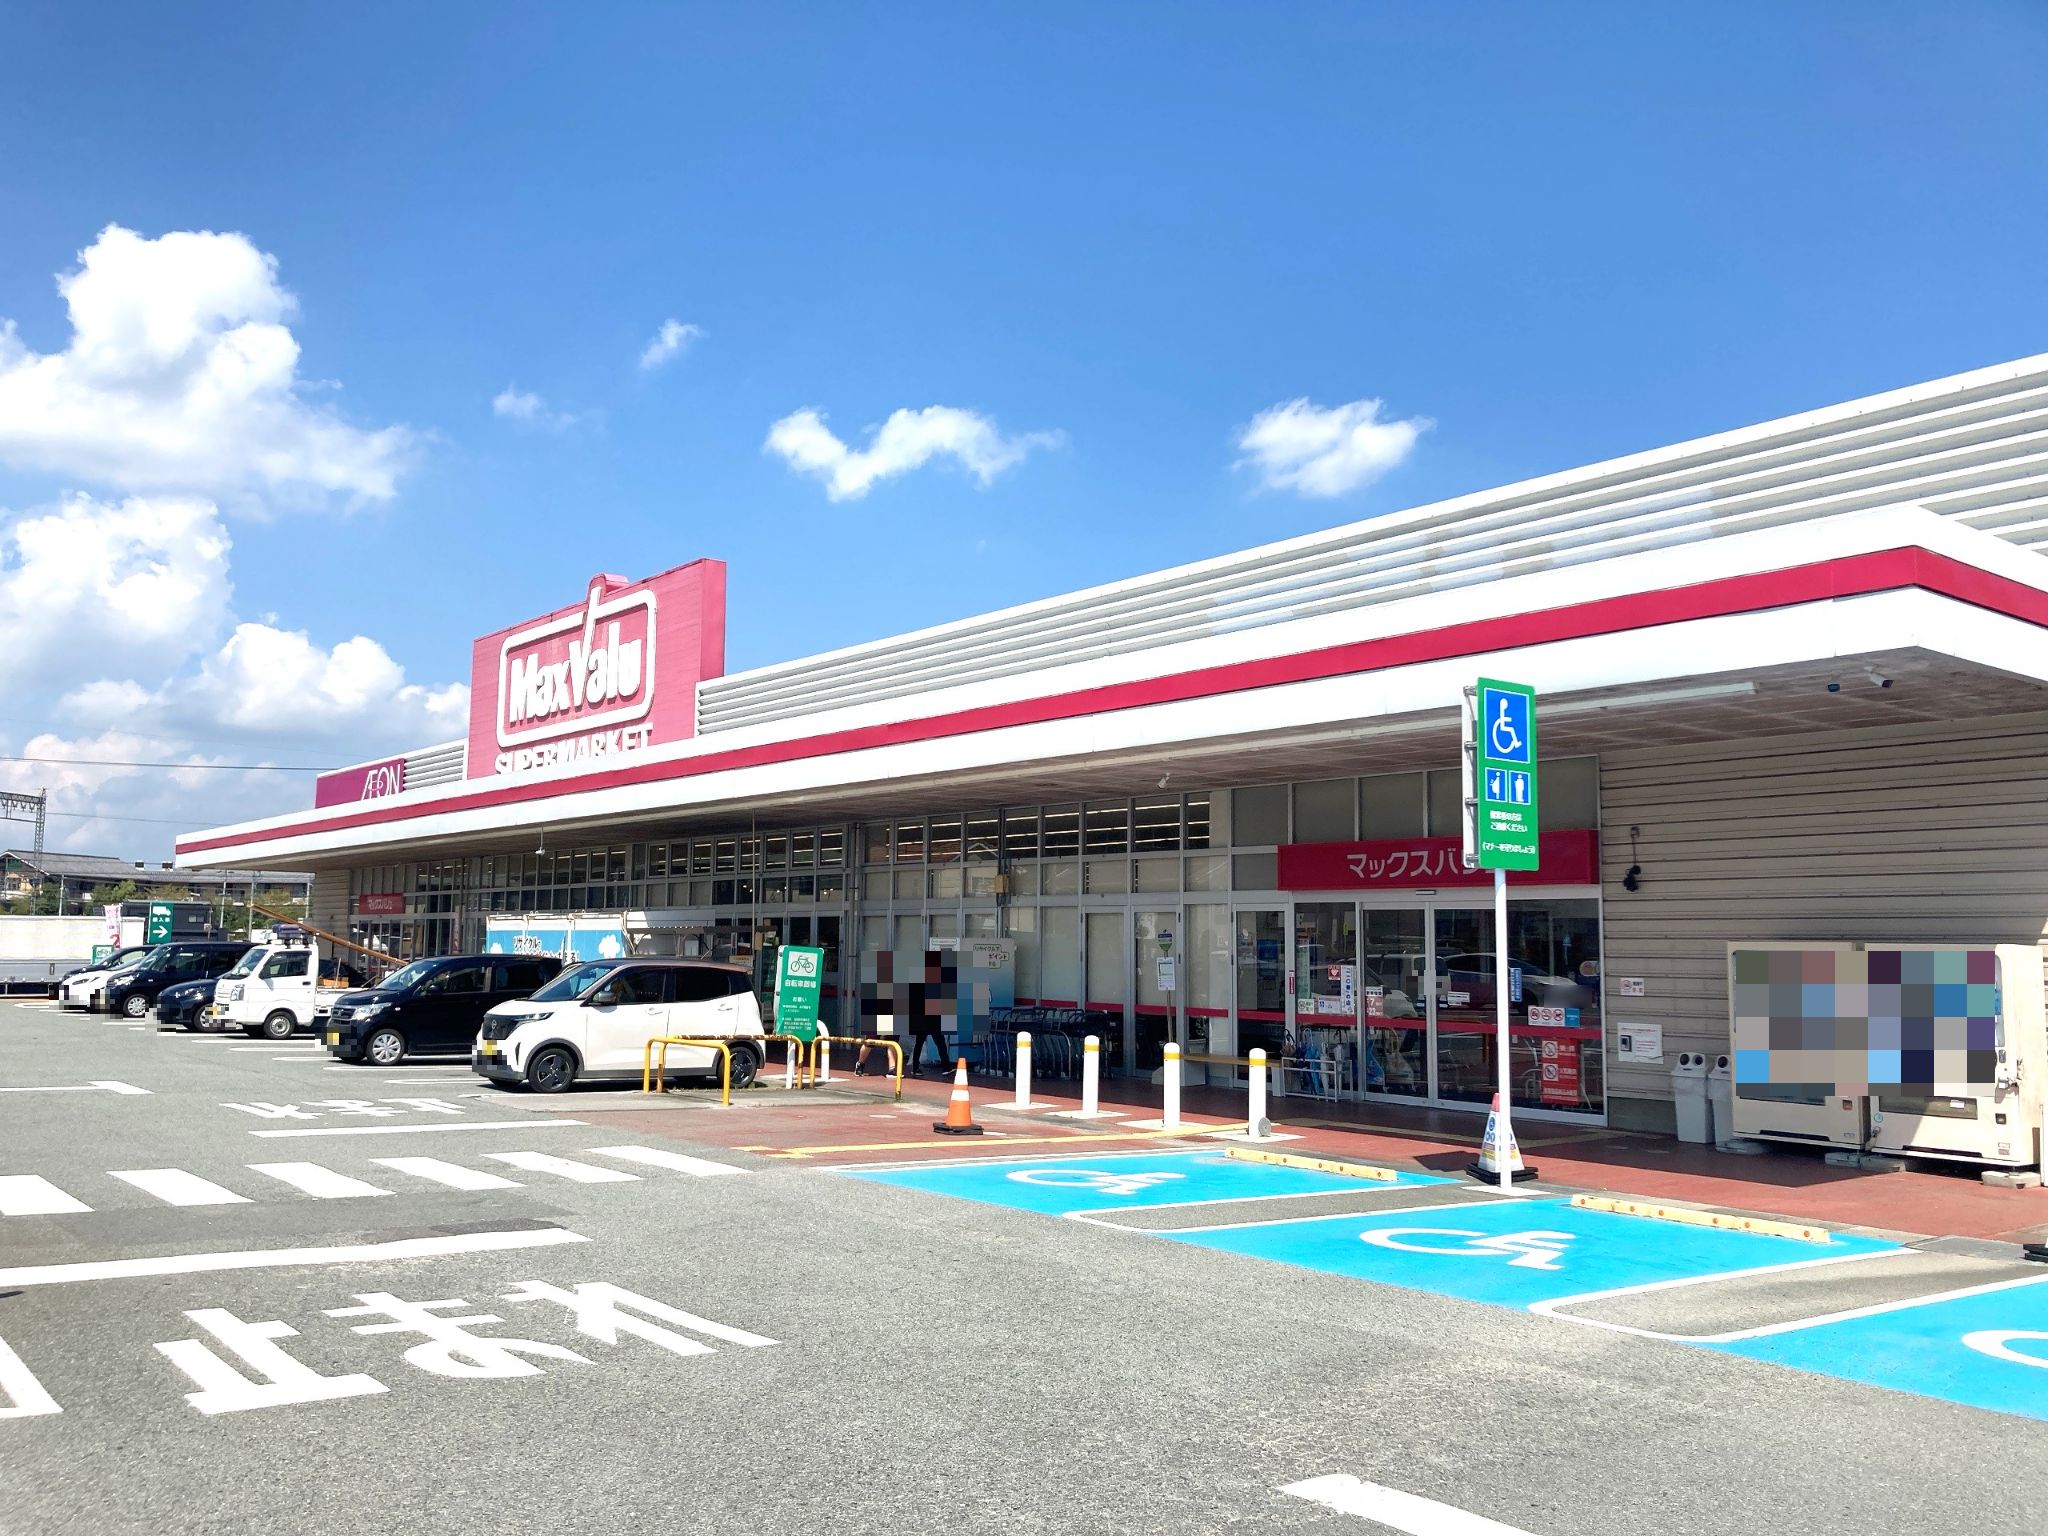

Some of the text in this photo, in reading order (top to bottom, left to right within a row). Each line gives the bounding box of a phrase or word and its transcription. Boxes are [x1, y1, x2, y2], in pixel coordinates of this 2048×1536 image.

[509, 587, 642, 725] MaxValu
[1346, 848, 1497, 879] マックスバ
[153, 1280, 780, 1415] 止まれ
